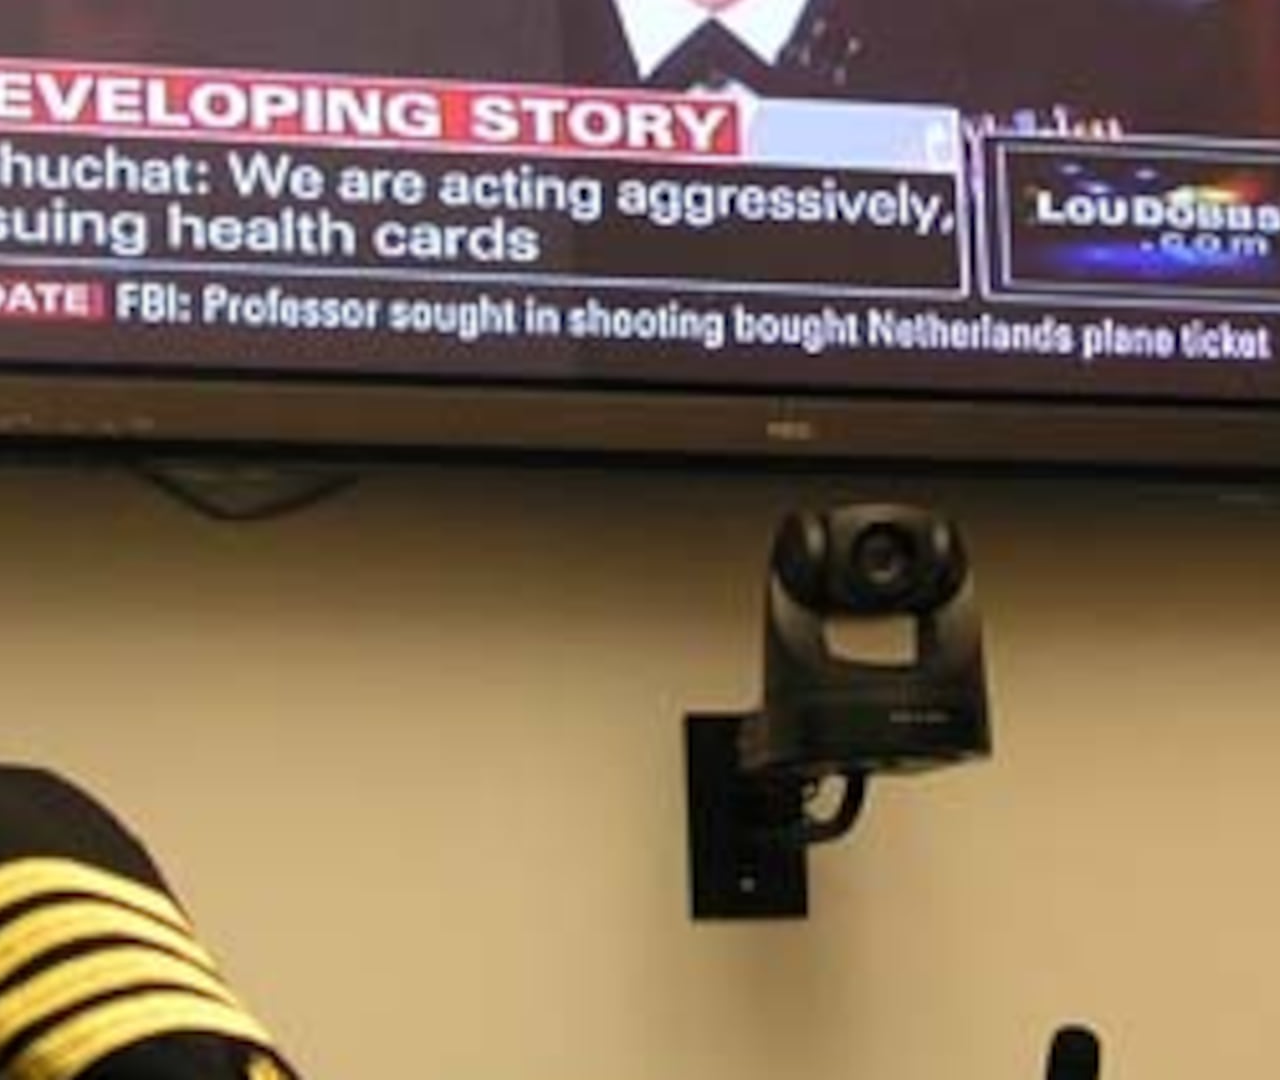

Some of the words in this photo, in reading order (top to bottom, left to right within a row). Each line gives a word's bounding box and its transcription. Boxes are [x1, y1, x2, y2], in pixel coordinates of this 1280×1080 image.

[472, 96, 729, 151] STORY
[229, 151, 323, 200] We
[338, 167, 424, 205] are
[439, 165, 602, 216] acting
[618, 177, 955, 235] aggressively,
[167, 204, 356, 256] health
[373, 218, 540, 263] cards
[116, 283, 192, 324] FBI:
[203, 286, 378, 329] Professor
[389, 294, 516, 341] sought
[525, 297, 560, 335] in
[567, 298, 723, 349] shooting
[734, 303, 860, 354] bought
[867, 310, 1073, 356] Netherlands
[1083, 319, 1173, 361] plane
[1180, 322, 1272, 360] ticket
